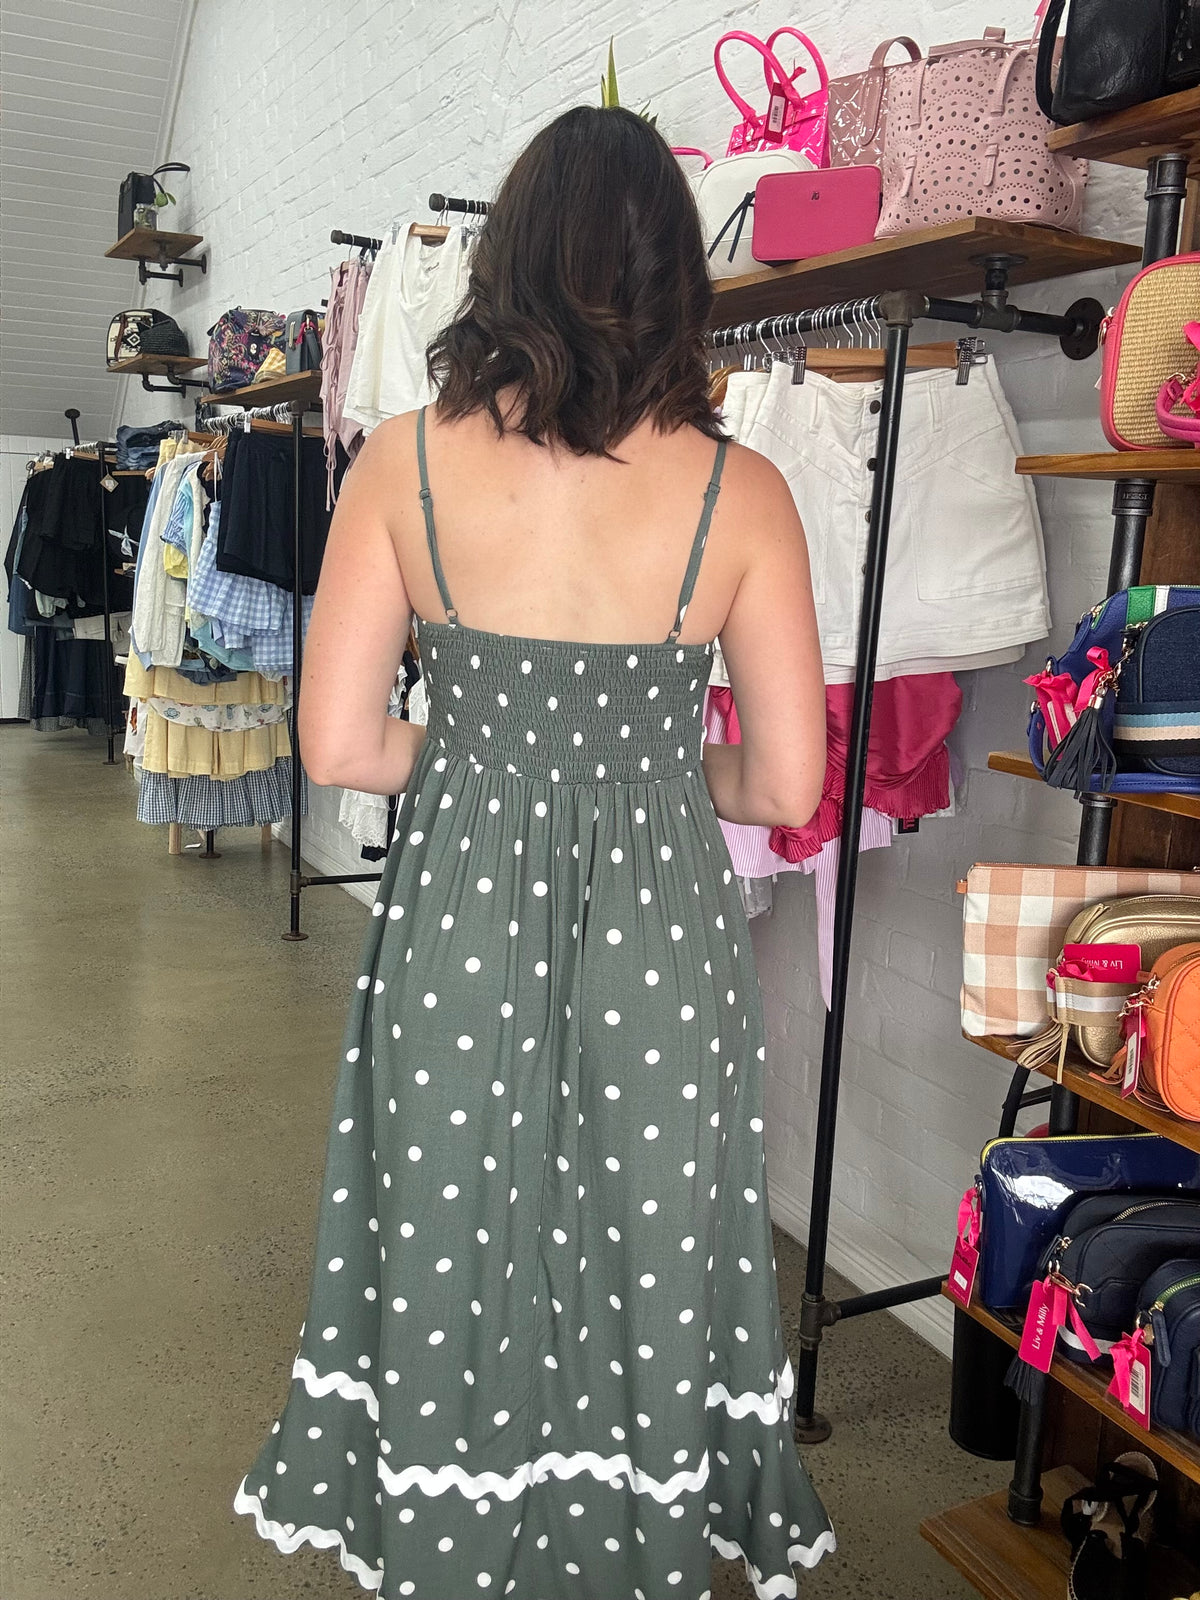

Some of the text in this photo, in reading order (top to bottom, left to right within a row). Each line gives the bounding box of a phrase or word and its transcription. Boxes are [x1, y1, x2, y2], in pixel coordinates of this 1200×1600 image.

[1102, 959, 1108, 968] &
[1110, 960, 1123, 969] Liv
[1032, 1303, 1050, 1350] Liv & Milly
